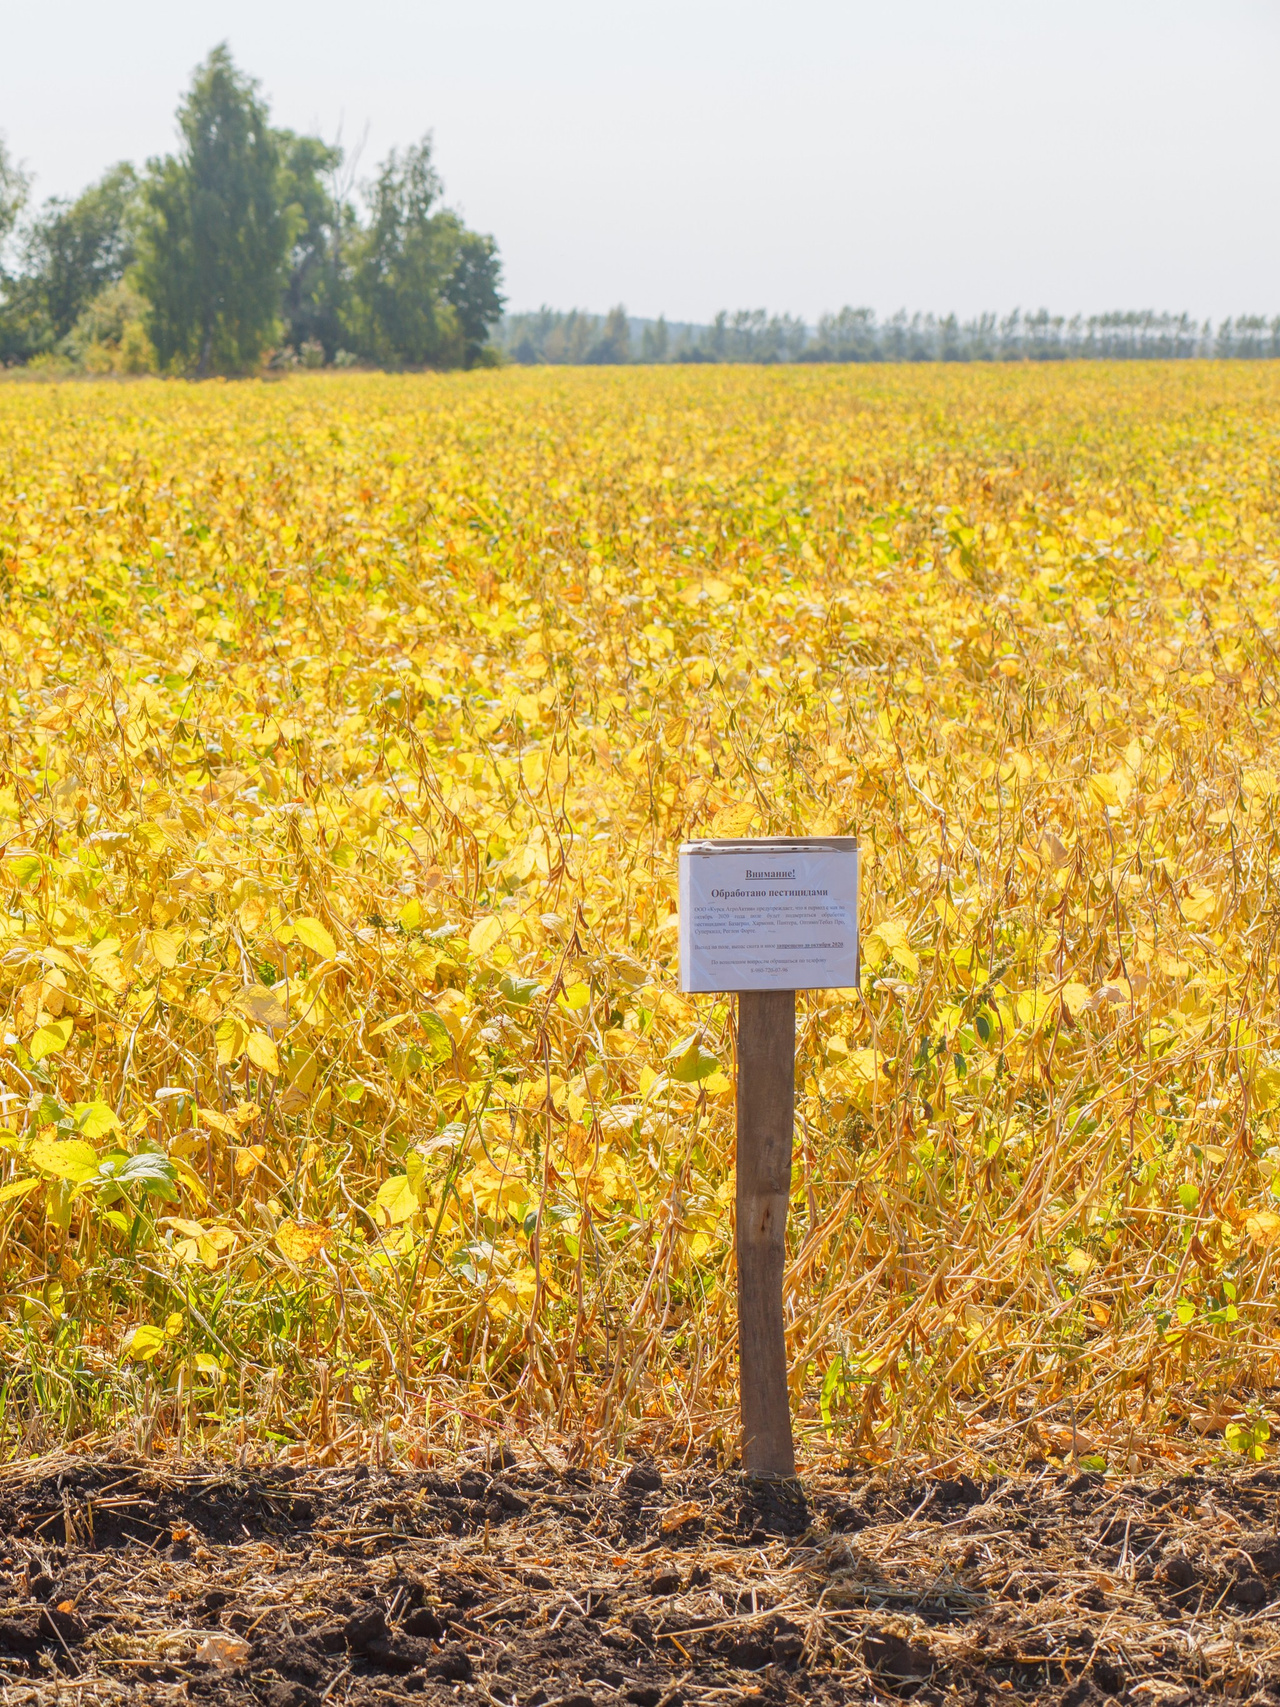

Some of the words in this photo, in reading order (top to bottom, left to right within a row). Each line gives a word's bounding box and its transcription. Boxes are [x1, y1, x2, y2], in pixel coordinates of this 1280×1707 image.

[745, 869, 796, 880] Внимание!
[711, 889, 766, 899] Обработано
[768, 889, 828, 897] пестицидами
